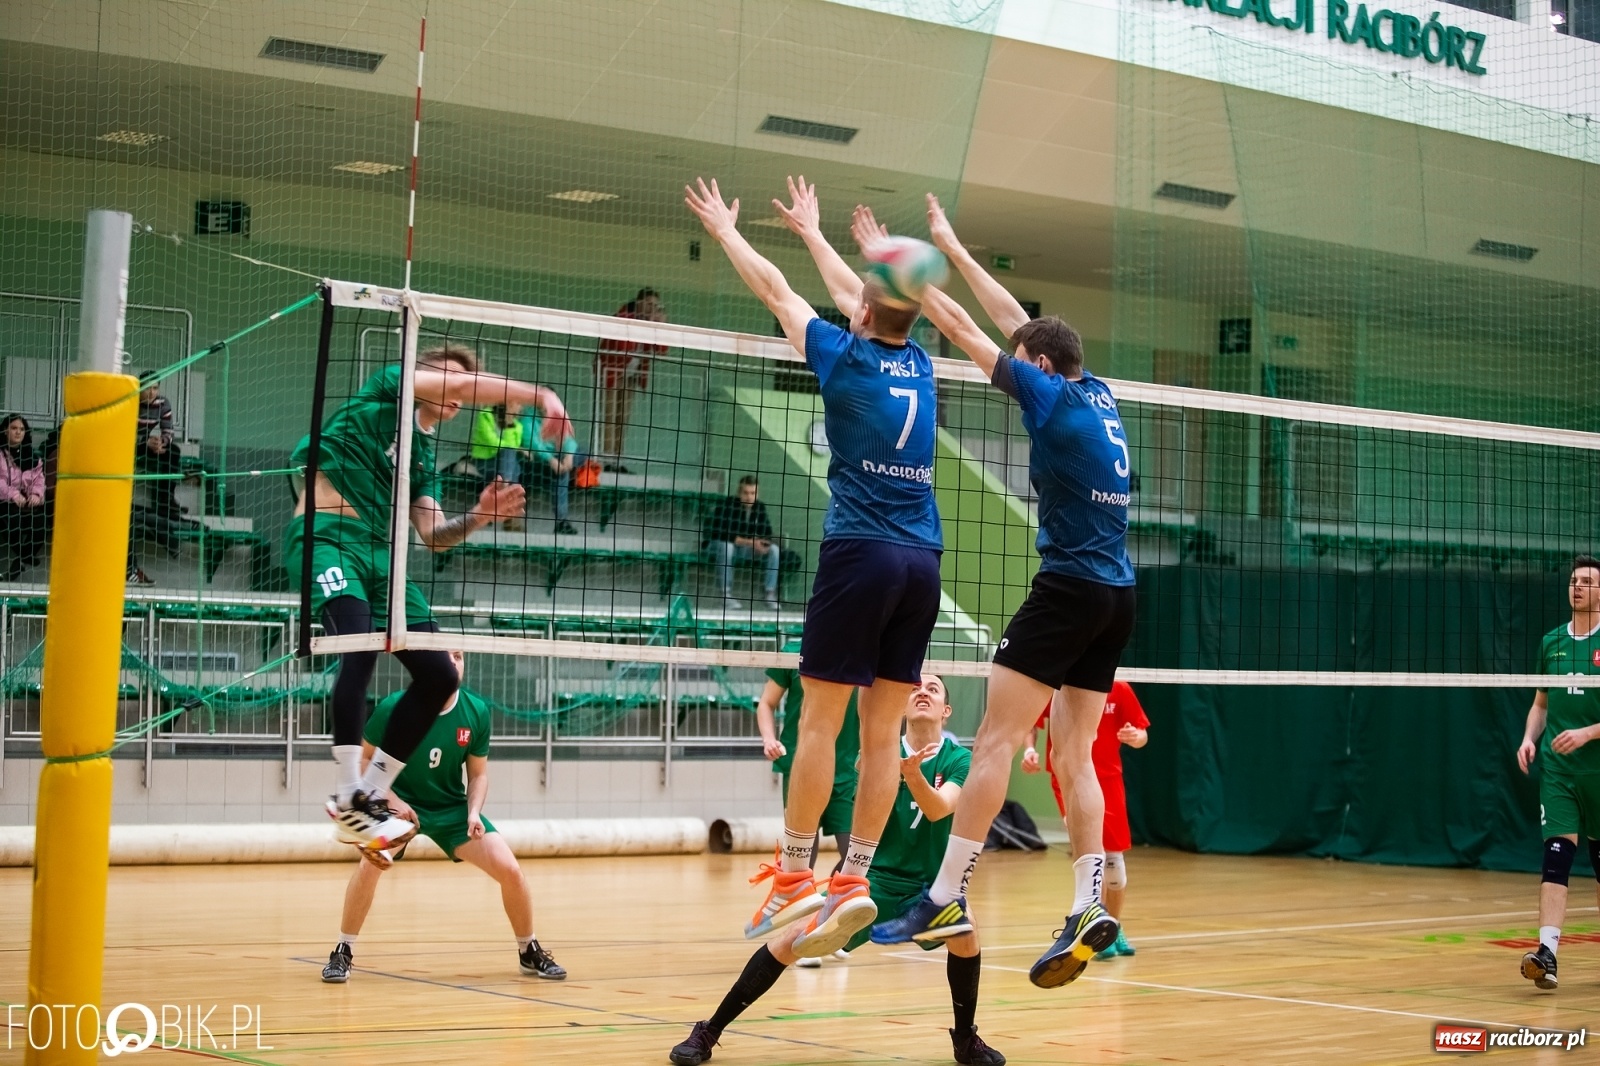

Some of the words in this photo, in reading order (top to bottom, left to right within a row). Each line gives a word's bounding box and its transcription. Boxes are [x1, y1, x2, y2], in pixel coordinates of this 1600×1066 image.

[1328, 0, 1487, 75] RACIBÓRZ
[208, 212, 230, 232] E
[889, 386, 918, 450] 7
[1103, 418, 1129, 477] 5
[316, 566, 348, 598] 10
[429, 747, 442, 769] 9
[909, 801, 924, 829] 7
